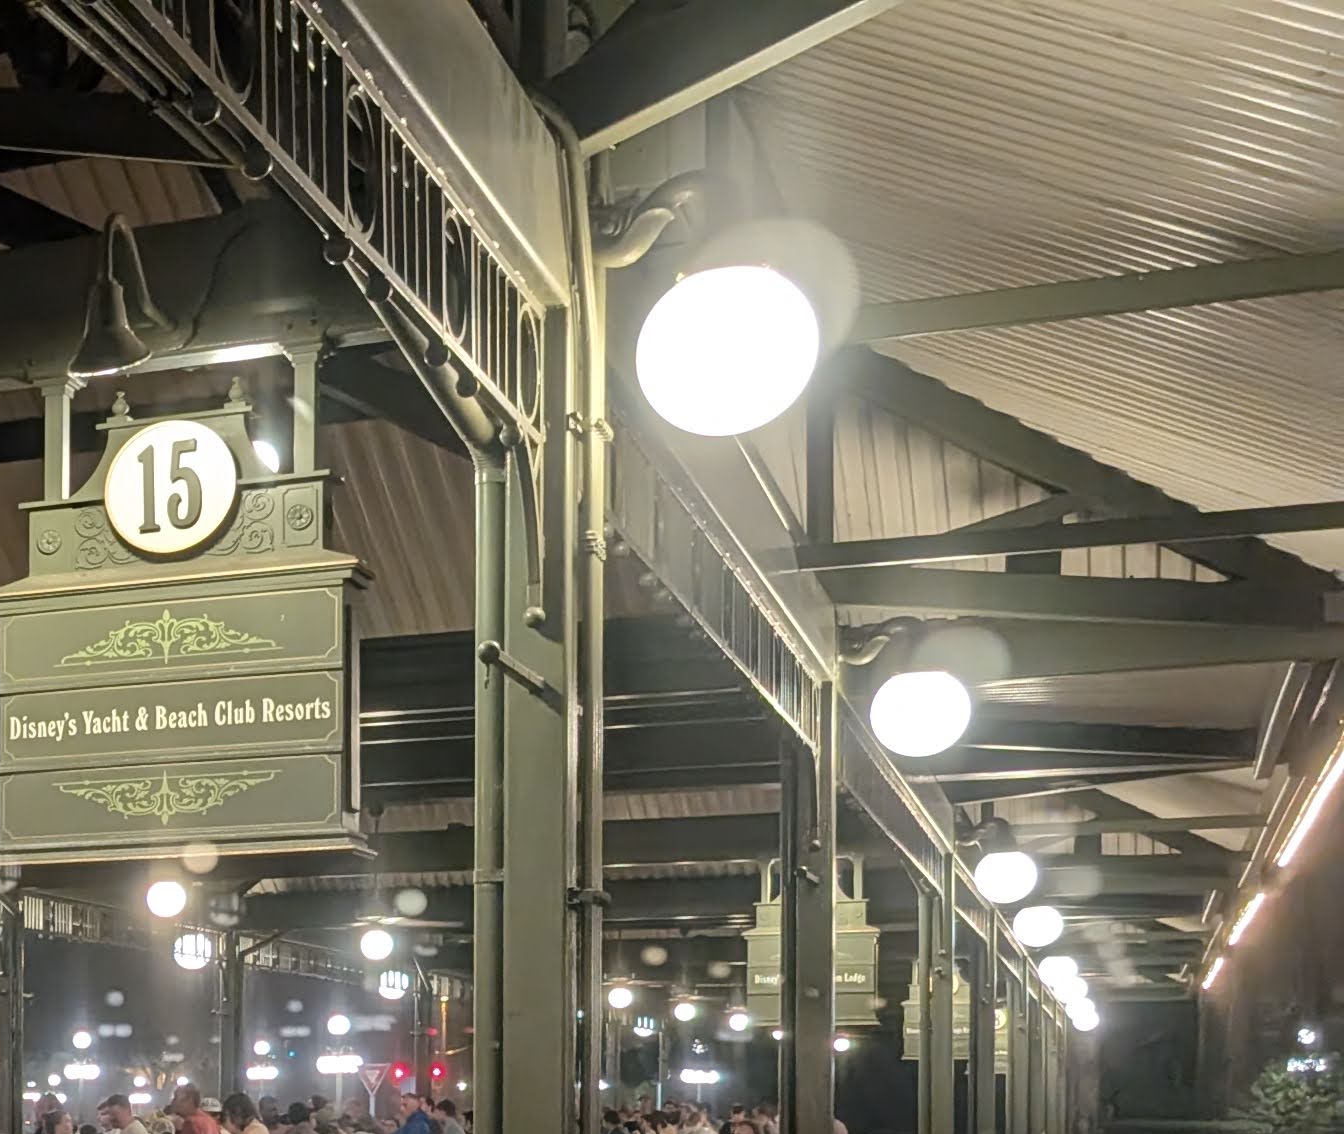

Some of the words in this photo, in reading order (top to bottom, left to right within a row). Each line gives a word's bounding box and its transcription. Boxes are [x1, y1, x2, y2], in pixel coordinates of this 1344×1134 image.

[136, 438, 203, 535] 15
[9, 711, 77, 742] Disney's
[82, 708, 130, 735] Yacht
[134, 706, 149, 732] &
[155, 702, 209, 730] Beach
[214, 699, 256, 726] Club
[262, 697, 332, 723] Resorts
[754, 973, 783, 985] Disney'
